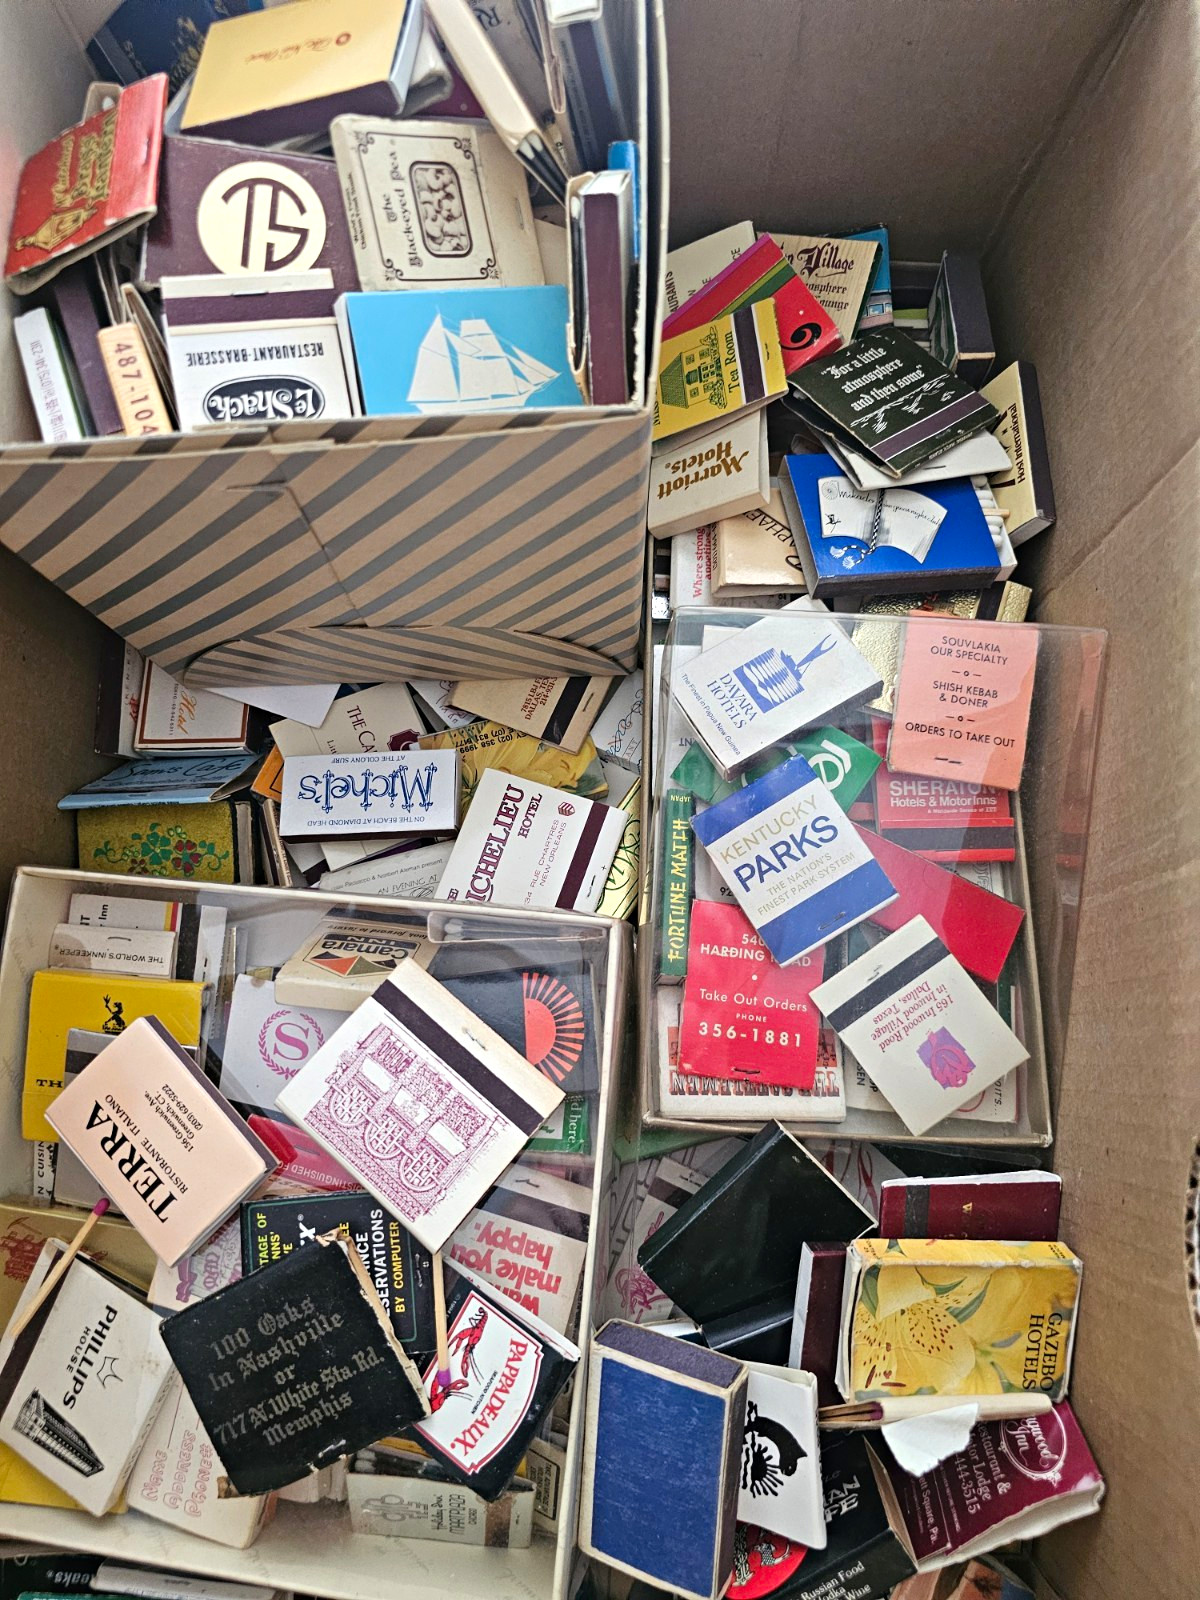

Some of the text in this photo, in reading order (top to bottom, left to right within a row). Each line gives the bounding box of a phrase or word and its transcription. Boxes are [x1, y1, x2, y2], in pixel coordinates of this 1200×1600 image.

[386, 193, 397, 223] The
[390, 150, 423, 267] Black-eyed Pea
[797, 242, 854, 278] Village
[724, 331, 740, 393] Tea Room
[841, 357, 904, 394] atmosphere
[852, 360, 859, 369] a
[859, 346, 887, 365] little
[851, 391, 874, 412] and
[873, 380, 898, 402] then
[1009, 403, 1026, 484] Host International
[657, 450, 749, 500] Marriott
[693, 528, 706, 599] Where strong
[930, 645, 1008, 666] OUR SPECIALTY
[942, 636, 1001, 653] SOUVLAKIA
[520, 695, 533, 713] 7815
[527, 679, 541, 697] LBJ
[523, 689, 544, 721] DALLAS,
[706, 678, 747, 729] HOTELS
[717, 671, 759, 723] DAVARA
[932, 680, 999, 698] SHISH KEBAB
[939, 692, 988, 708] & DONER
[346, 705, 366, 731] THE
[490, 727, 505, 737] (07)
[679, 672, 741, 756] The Finest in Papua New Guinea
[459, 743, 478, 753] 1999
[480, 738, 495, 747] 358
[496, 732, 513, 743] (02)
[905, 722, 1015, 748] ORDERS TO TAKE OUT
[518, 793, 543, 838] HOTEL
[890, 796, 997, 807] Hotels & Motor Inns
[466, 783, 525, 902] ICHELIEU
[719, 795, 818, 865] KENTUCKY
[420, 857, 443, 869] present
[530, 819, 560, 888] RUE CHARTRES
[539, 822, 567, 887] NEW ORLEANS
[733, 815, 838, 893] PARKS
[376, 874, 438, 895] AN EVENING AT
[668, 818, 689, 963] FORTUNE MATCH
[757, 853, 856, 916] FINEST PARK SYSTEM
[766, 853, 832, 897] THE NATION'S
[98, 904, 109, 920] Inn
[369, 926, 406, 937] forward
[108, 953, 146, 963] WORLD'S
[320, 938, 409, 960] Camara
[346, 935, 395, 946] INN
[700, 944, 765, 962] HARDING
[700, 987, 808, 1014] Take Out Orders
[735, 1013, 768, 1023] PHONE
[870, 983, 948, 1042] in Inwood Village
[871, 979, 932, 1026] Dallas, Texas
[698, 1022, 801, 1048] 356-1881
[878, 994, 954, 1053] 165 Inwood Road
[141, 1090, 194, 1152] 156 Greenwich Ave.
[152, 1090, 195, 1140] Greenwich, CT.
[160, 1082, 203, 1131] (203) 629-5222
[85, 1100, 178, 1223] TERRA
[105, 1095, 188, 1194] RISTORANTE ITALIANO
[289, 1163, 363, 1192] DISTINGUISHED
[468, 1217, 555, 1270] happy.
[389, 1221, 406, 1313] BY COMPUTER
[447, 1241, 562, 1294] make you
[67, 1326, 90, 1373] HOUSE
[210, 1297, 315, 1361] 100 Oaks
[63, 1304, 118, 1410] PHILLIPS
[209, 1312, 345, 1392] In Nashville
[1022, 1313, 1045, 1390] HOTELS
[1040, 1312, 1062, 1392] GAZEBO
[274, 1363, 295, 1386] or
[470, 1369, 498, 1414] SEAFOOD KITCHEN
[213, 1415, 248, 1445] 717
[262, 1392, 353, 1446] Memphis
[1011, 1423, 1030, 1467] Inn
[974, 1463, 992, 1501] Lodge
[997, 1481, 1007, 1495] &
[431, 1508, 447, 1530] Holiday
[801, 1561, 865, 1600] Russian Food
[843, 1582, 871, 1600] Wine
